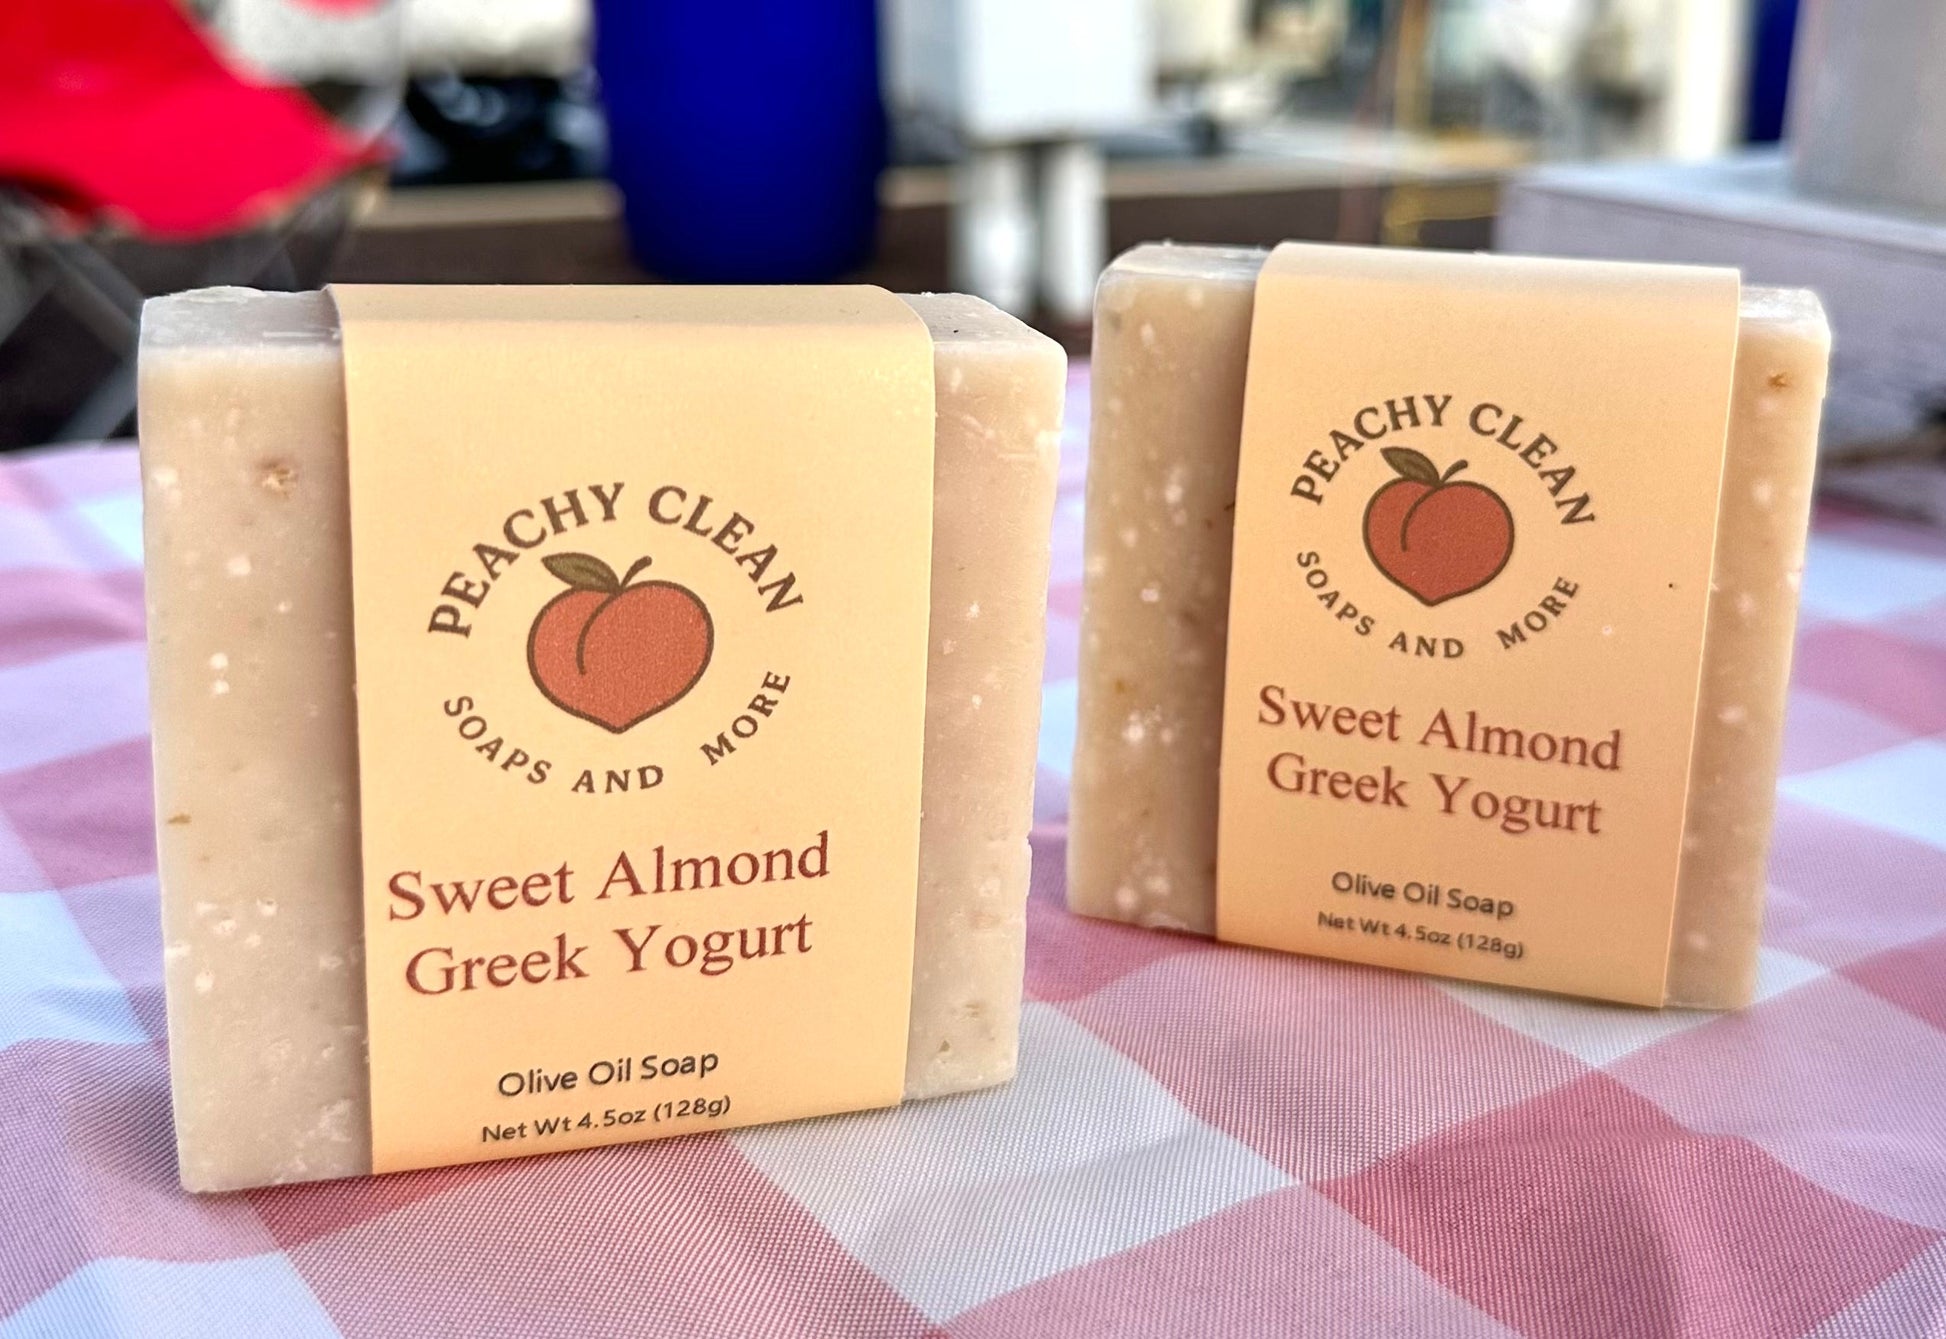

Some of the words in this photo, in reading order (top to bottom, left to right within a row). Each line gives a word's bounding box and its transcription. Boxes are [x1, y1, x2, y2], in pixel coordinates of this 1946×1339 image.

[1290, 394, 1453, 506] PEACHY
[1468, 403, 1596, 528] CLEAN
[427, 482, 625, 639] PEACHY
[648, 485, 804, 614] CLEAN
[1296, 550, 1376, 637] SOAPS
[1388, 630, 1465, 659] AND
[1495, 576, 1579, 651] MORE
[443, 695, 553, 785] SOAPS
[571, 764, 664, 794] AND
[699, 671, 792, 766] MORE
[1257, 684, 1402, 743] Sweet
[1418, 707, 1622, 771] Almond
[1266, 752, 1410, 809] Greek
[1428, 772, 1602, 835] Yogurt
[387, 860, 576, 921] Sweet
[595, 830, 831, 900] Almond
[1331, 871, 1396, 900] Olive
[1402, 881, 1440, 907] Oil
[1446, 887, 1514, 922] Soap
[404, 933, 591, 996] Greek
[611, 913, 814, 976] Yogurt
[1317, 910, 1356, 932] Net
[1359, 917, 1391, 937] Wt
[1394, 922, 1452, 946] 4.5oz
[1456, 931, 1525, 961] (128g)
[498, 1067, 579, 1098] Olive
[587, 1057, 632, 1086] Oil
[640, 1050, 720, 1080] Soap
[481, 1122, 528, 1144] Net
[533, 1114, 573, 1136] Wt
[576, 1106, 647, 1131] 4.5oz
[652, 1094, 732, 1122] (128g)
